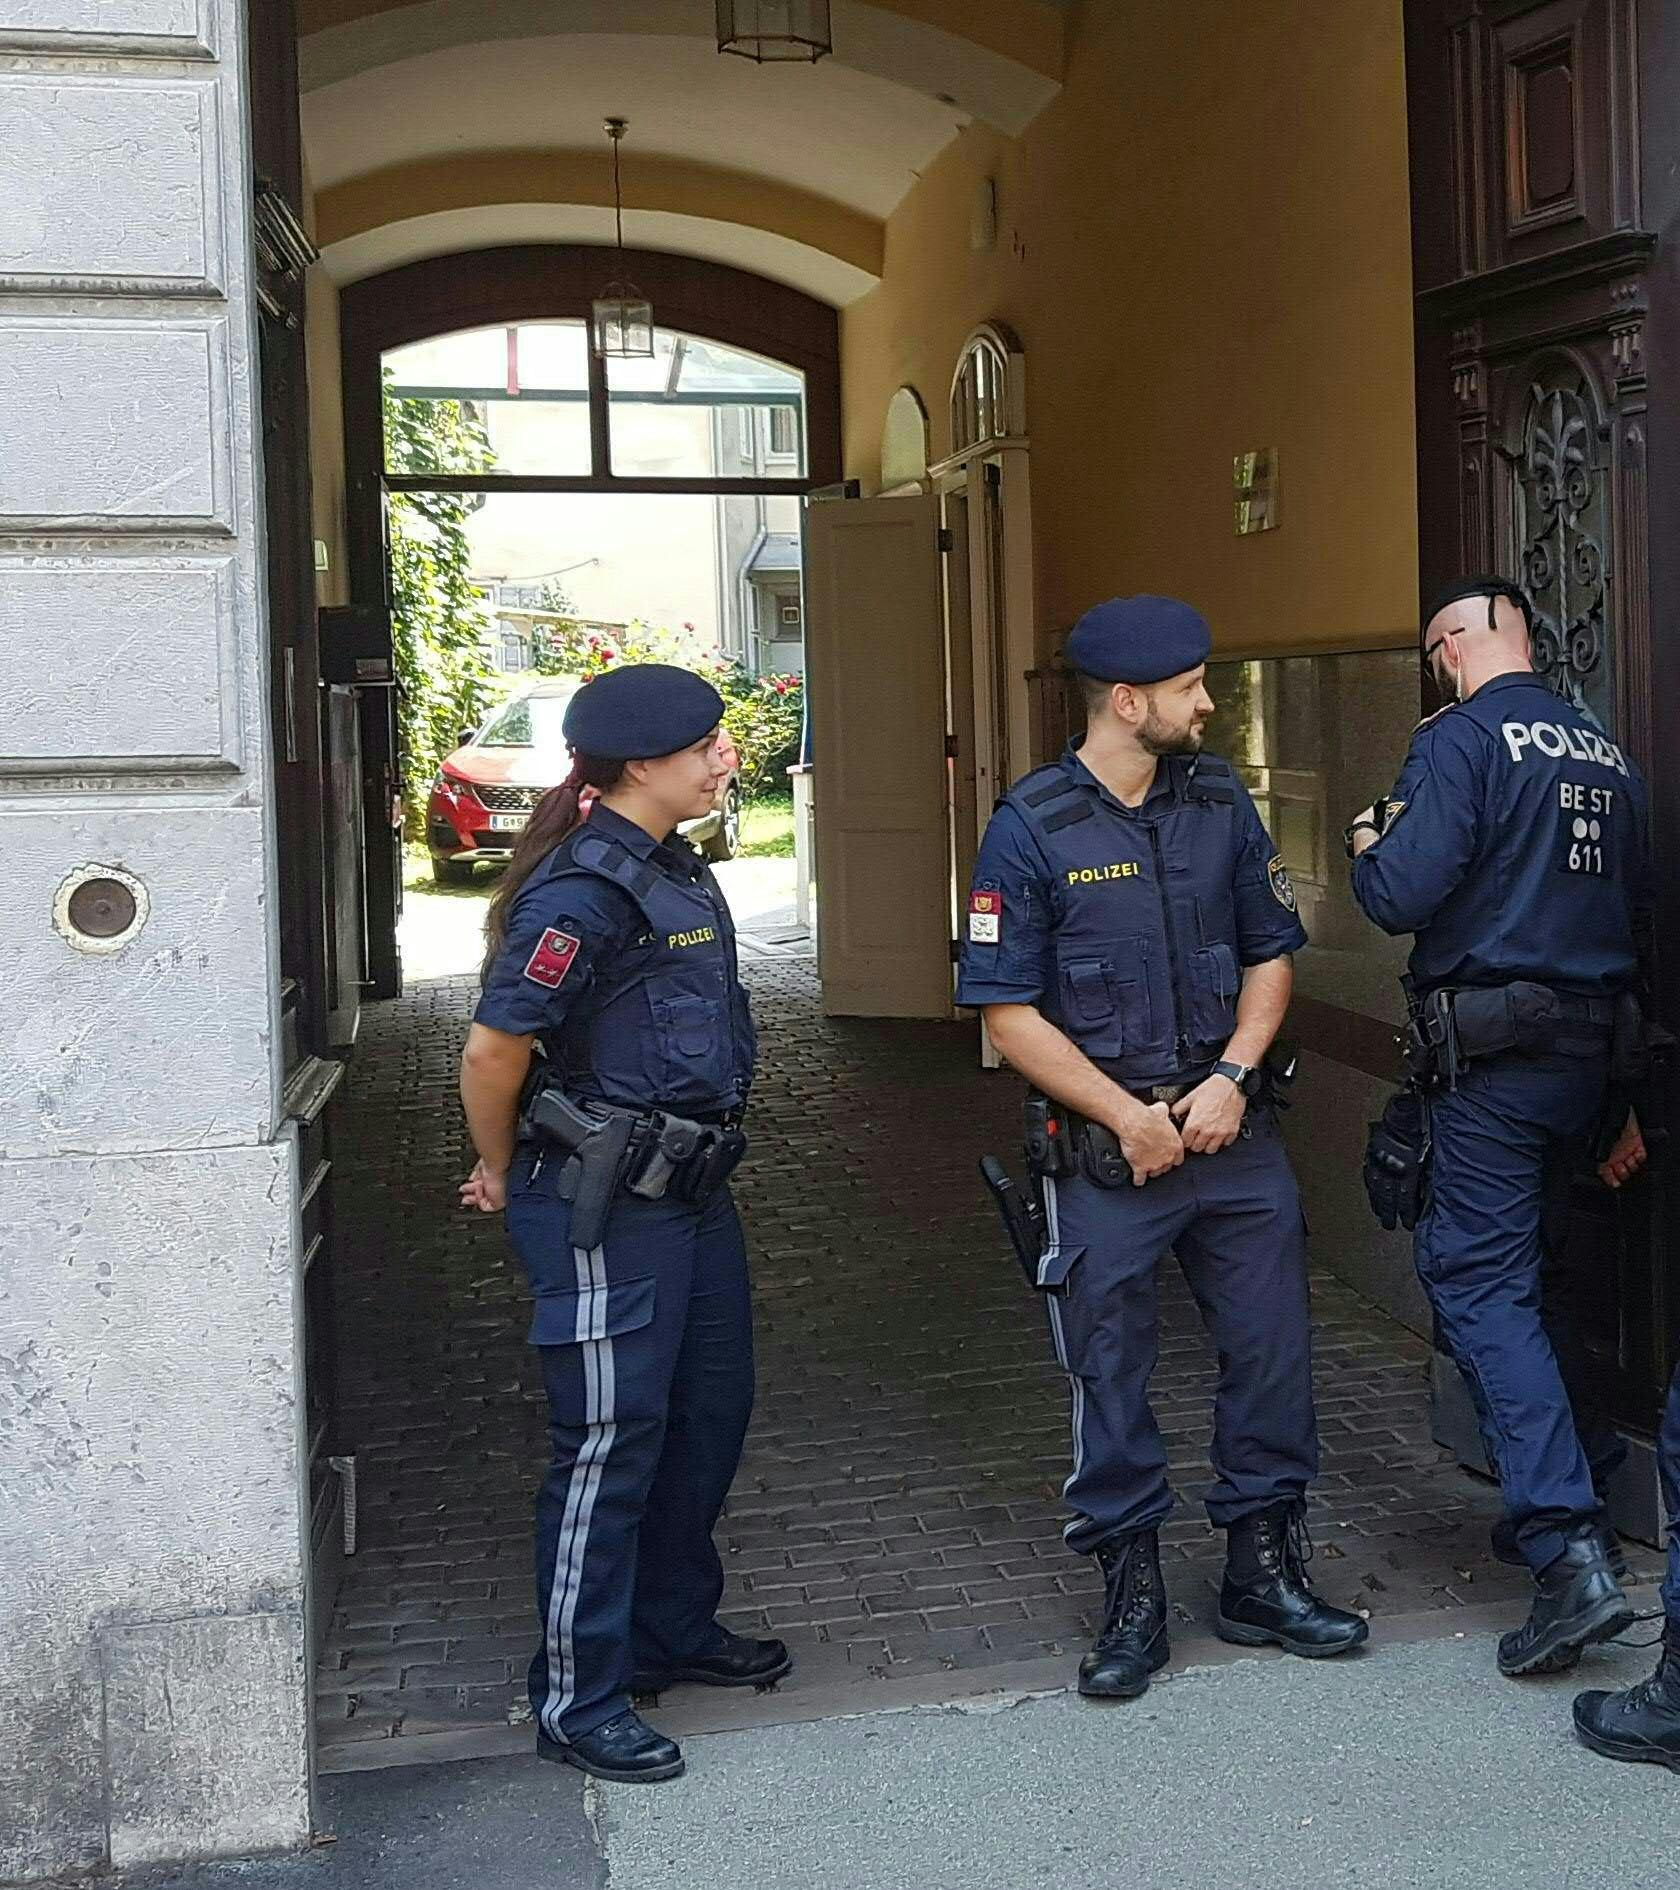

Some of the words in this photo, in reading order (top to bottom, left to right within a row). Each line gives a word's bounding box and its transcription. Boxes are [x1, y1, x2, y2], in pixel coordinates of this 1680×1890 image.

[1569, 843, 1602, 873] 611
[1068, 862, 1139, 886] POLIZEI
[668, 926, 715, 949] POLIZEI
